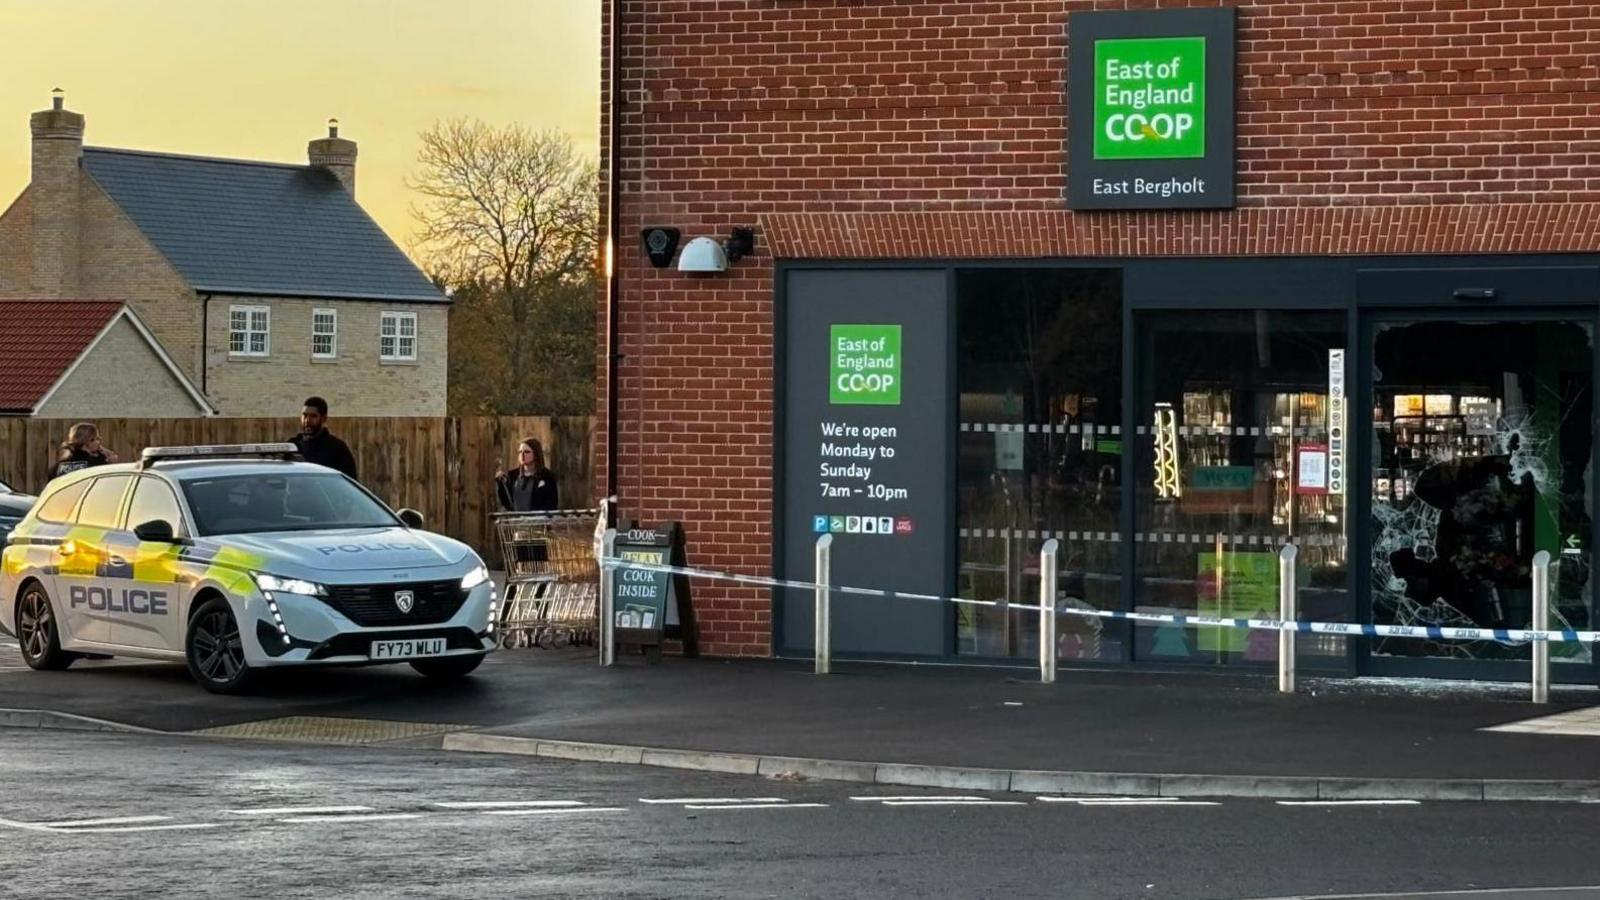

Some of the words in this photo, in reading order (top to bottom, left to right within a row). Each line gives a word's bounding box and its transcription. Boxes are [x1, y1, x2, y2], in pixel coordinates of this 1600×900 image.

[1105, 58, 1153, 80] East
[1156, 56, 1180, 79] of
[1105, 82, 1194, 109] England
[1093, 178, 1129, 194] East
[1134, 177, 1205, 197] Bergholt
[837, 336, 868, 351] East
[870, 336, 886, 351] of
[837, 353, 894, 371] England
[821, 422, 859, 436] We're
[862, 426, 896, 440] open
[821, 442, 876, 460] Monday
[879, 445, 895, 458] to
[820, 462, 871, 480] Sunday
[820, 482, 851, 497] 7am
[867, 483, 908, 501] 10pm
[627, 528, 657, 540] COOK
[623, 569, 655, 582] COOK
[618, 584, 657, 598] INSIDE
[70, 586, 168, 615] POLICE
[377, 641, 413, 657] FY73
[416, 640, 442, 655] WLU
